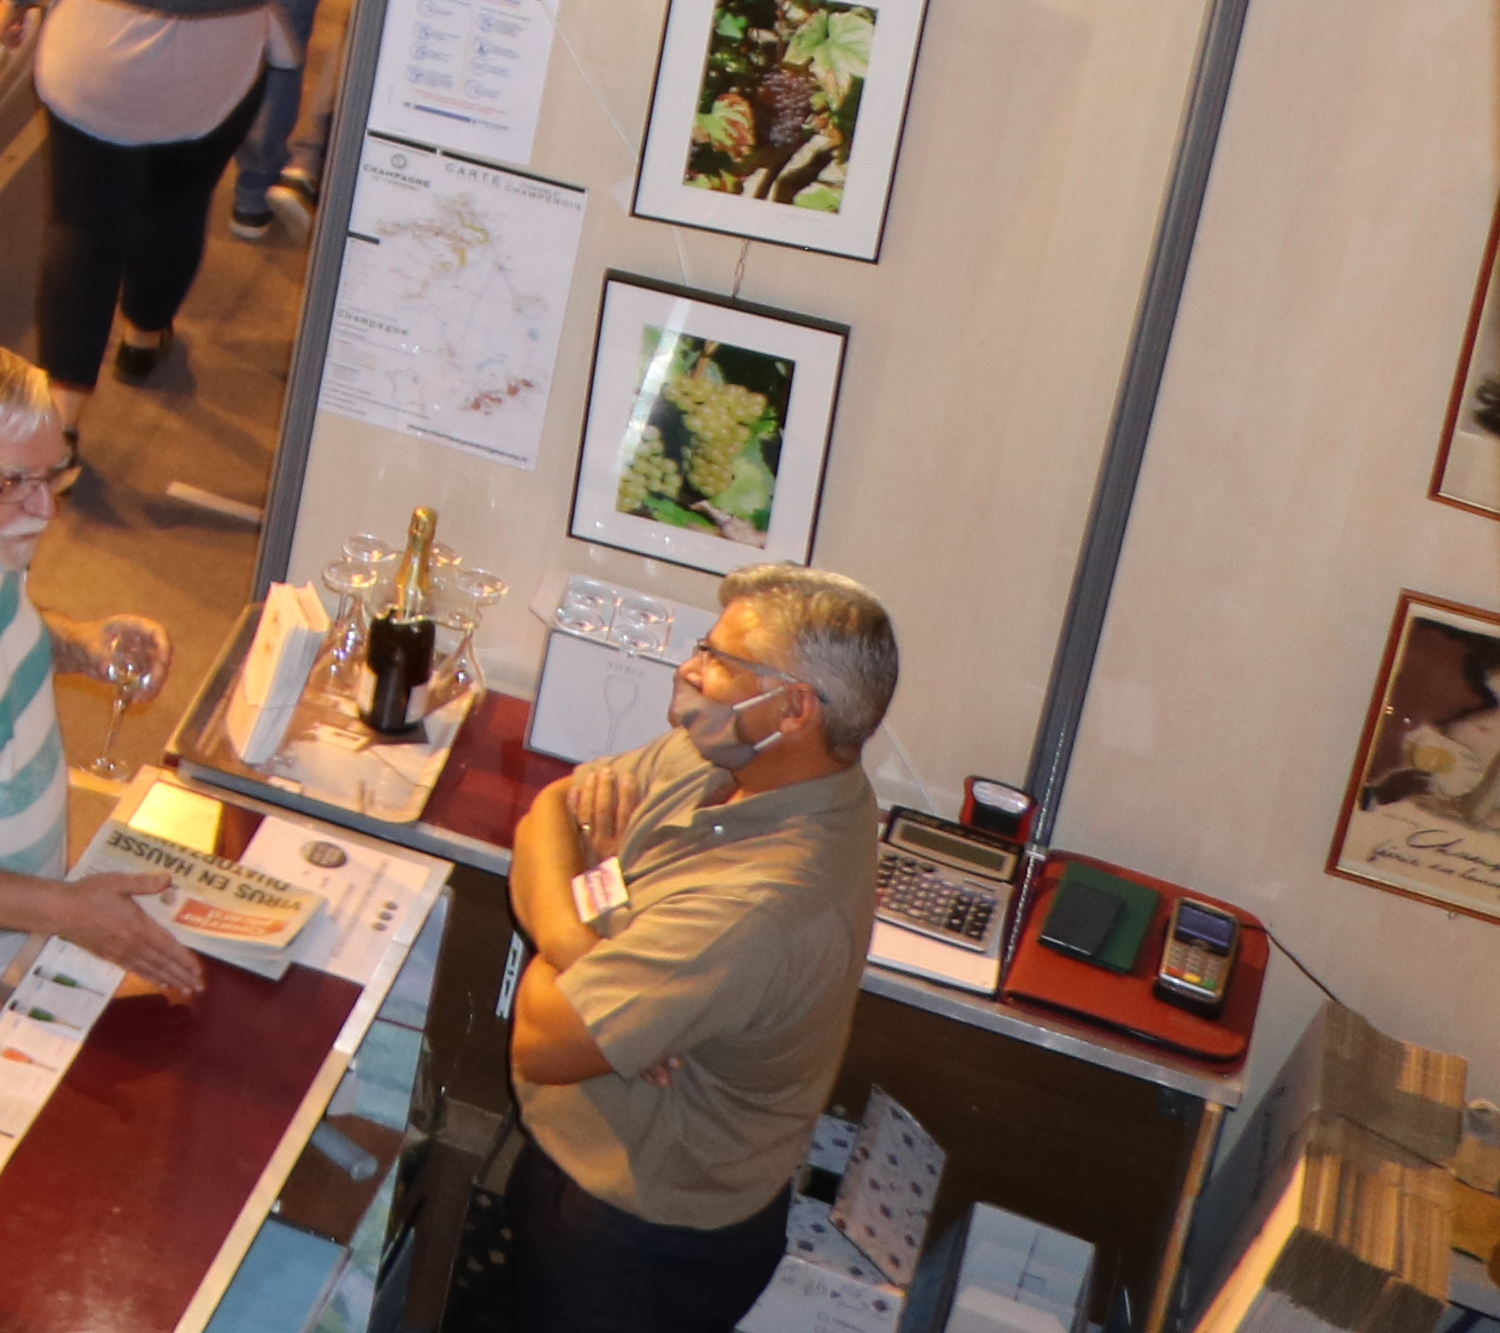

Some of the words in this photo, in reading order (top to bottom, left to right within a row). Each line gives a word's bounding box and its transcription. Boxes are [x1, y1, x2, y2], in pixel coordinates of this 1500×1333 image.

[361, 163, 431, 189] CHAMPAGNE
[443, 161, 502, 186] CARTE
[104, 829, 196, 879] HAUSSE
[197, 868, 232, 891] EN
[232, 882, 302, 912] VIRUS
